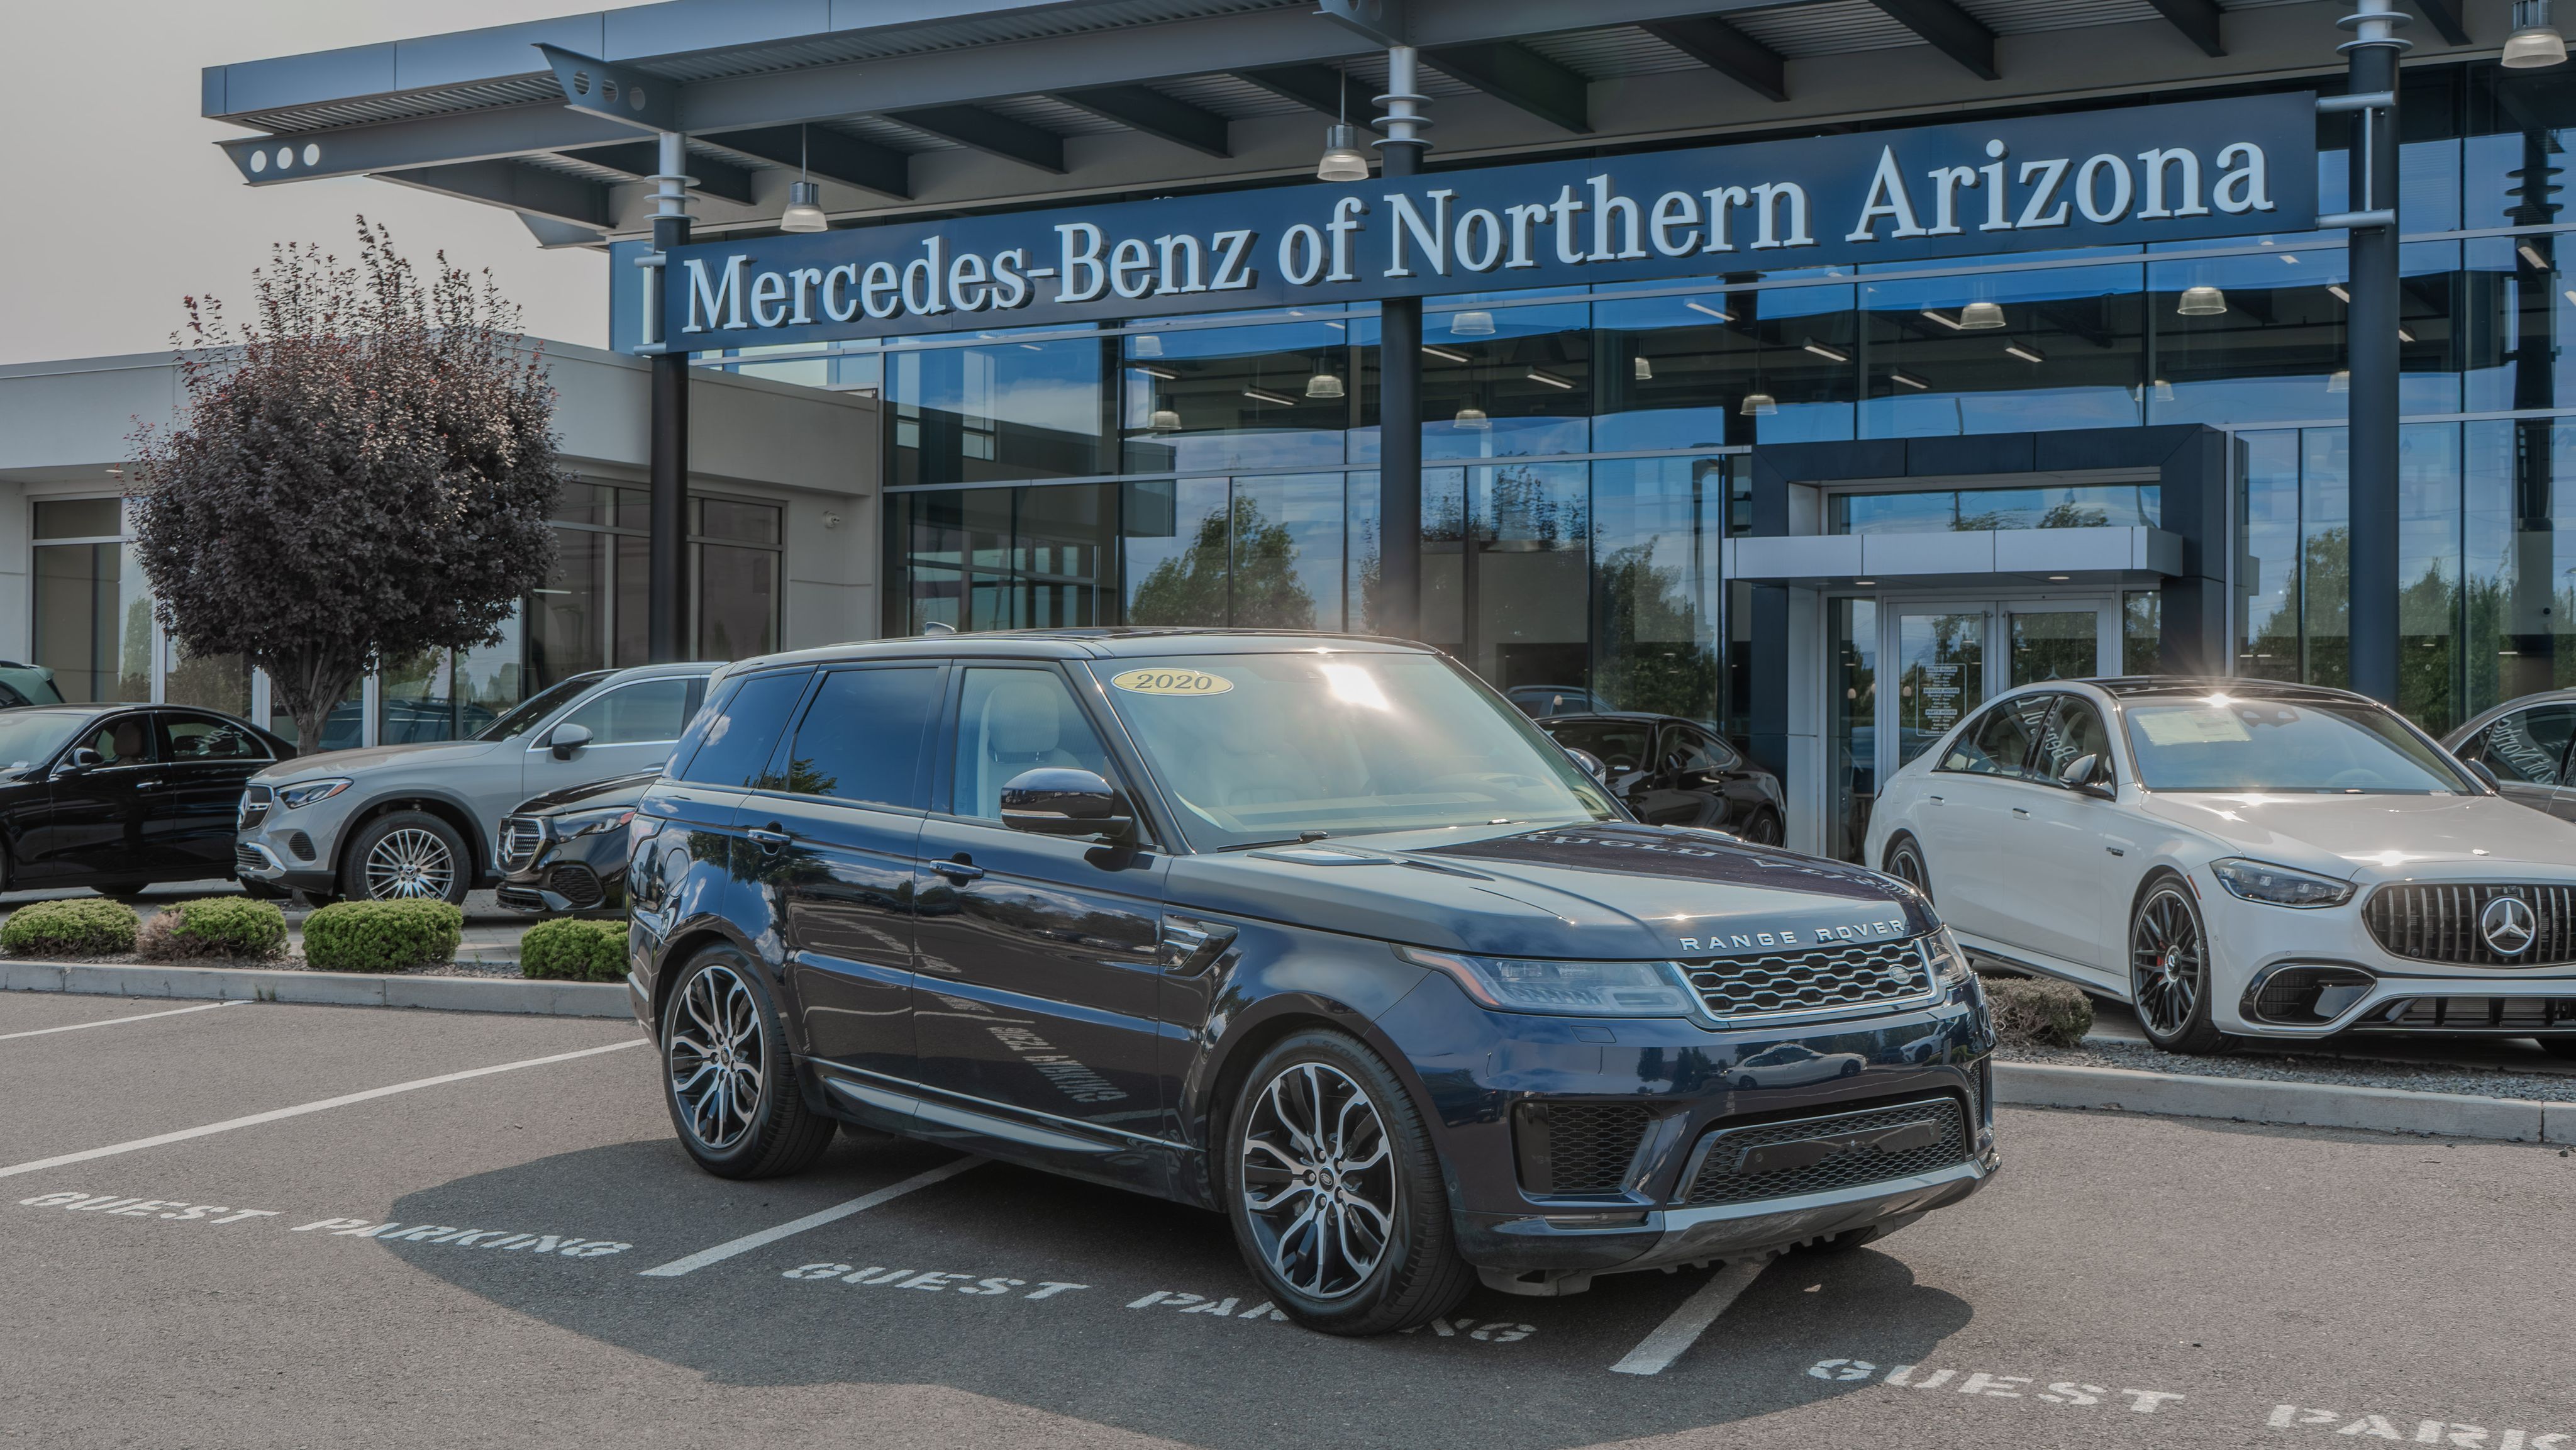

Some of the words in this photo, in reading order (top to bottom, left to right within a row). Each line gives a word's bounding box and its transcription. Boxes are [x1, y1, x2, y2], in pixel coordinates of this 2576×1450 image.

[682, 223, 1257, 333] Mercedes-Benz
[1279, 196, 1368, 287] of
[1384, 173, 1818, 277] Northern
[1845, 138, 2274, 242] Arizona
[1135, 674, 1212, 690] 2020
[1679, 930, 1797, 951] RANGE
[1814, 919, 1905, 941] ROVER
[19, 1191, 282, 1224] GUEST
[291, 1217, 633, 1257] PARKING
[782, 1262, 1091, 1300] GUEST
[1808, 1358, 2185, 1413] GUEST
